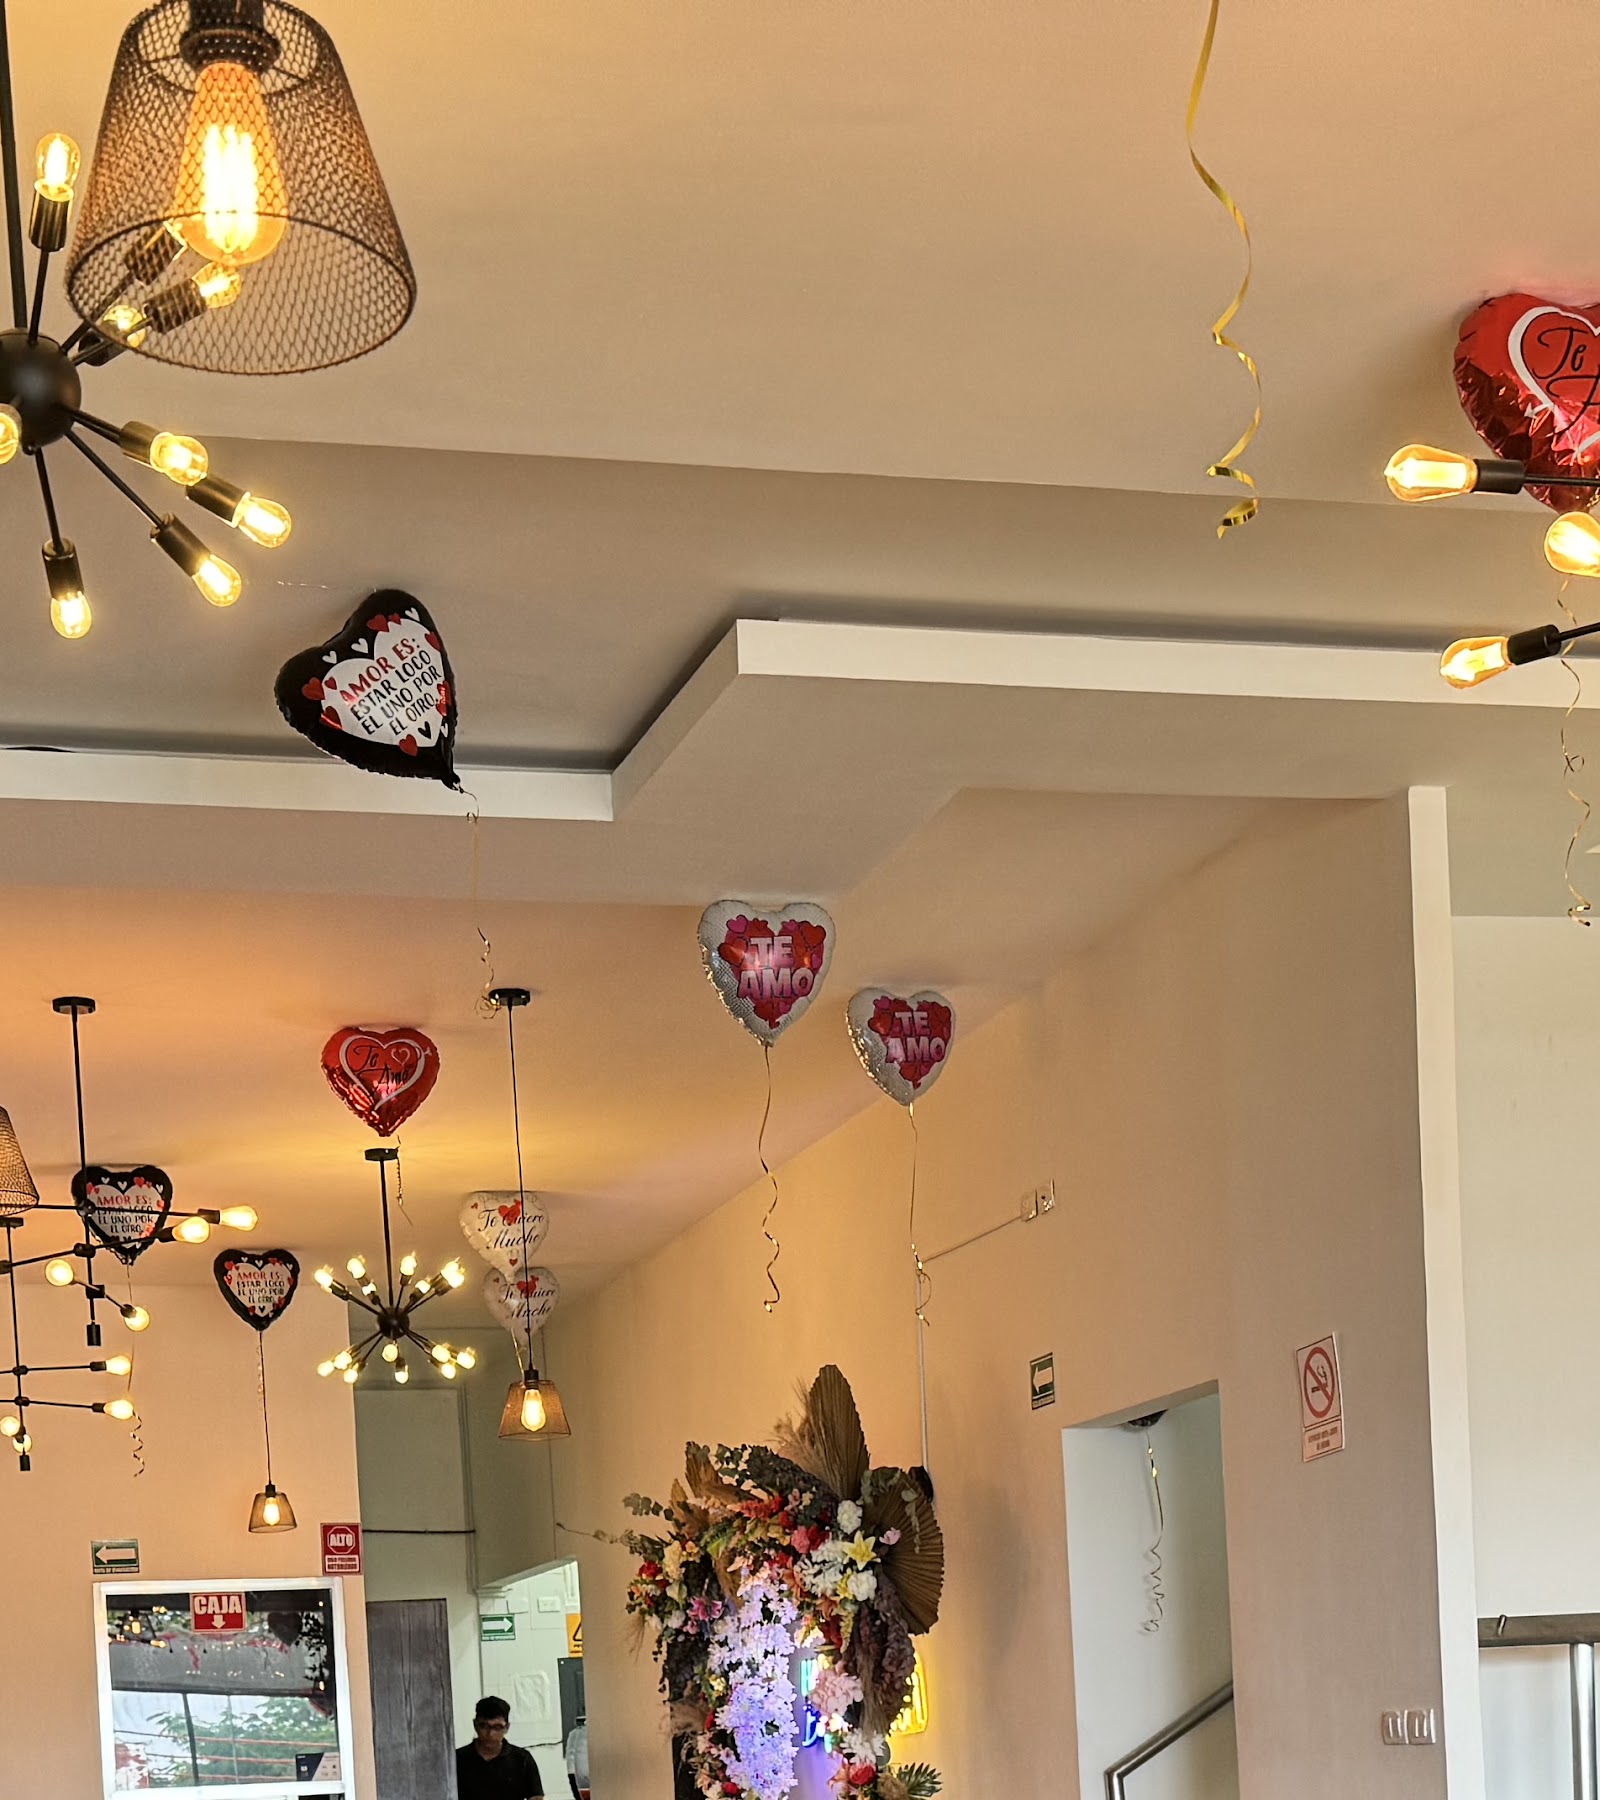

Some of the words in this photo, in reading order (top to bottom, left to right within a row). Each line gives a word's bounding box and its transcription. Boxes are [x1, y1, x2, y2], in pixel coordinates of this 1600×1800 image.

[1532, 327, 1588, 379] Te
[339, 656, 396, 706] AMOR
[392, 637, 421, 661] ES:
[350, 680, 398, 721] ESTAR
[395, 650, 431, 684] LOCO
[361, 717, 384, 735] EL
[380, 688, 413, 719] UNO
[413, 665, 442, 692] POR
[389, 718, 407, 736] EL
[406, 692, 438, 722] OTRO.
[749, 935, 794, 968] TE
[738, 968, 815, 999] AMO
[894, 1011, 931, 1036] TE
[886, 1036, 946, 1064] AMO
[97, 1195, 131, 1205] AMOR
[330, 1534, 353, 1546] ALTO
[194, 1596, 242, 1614] CAJA
